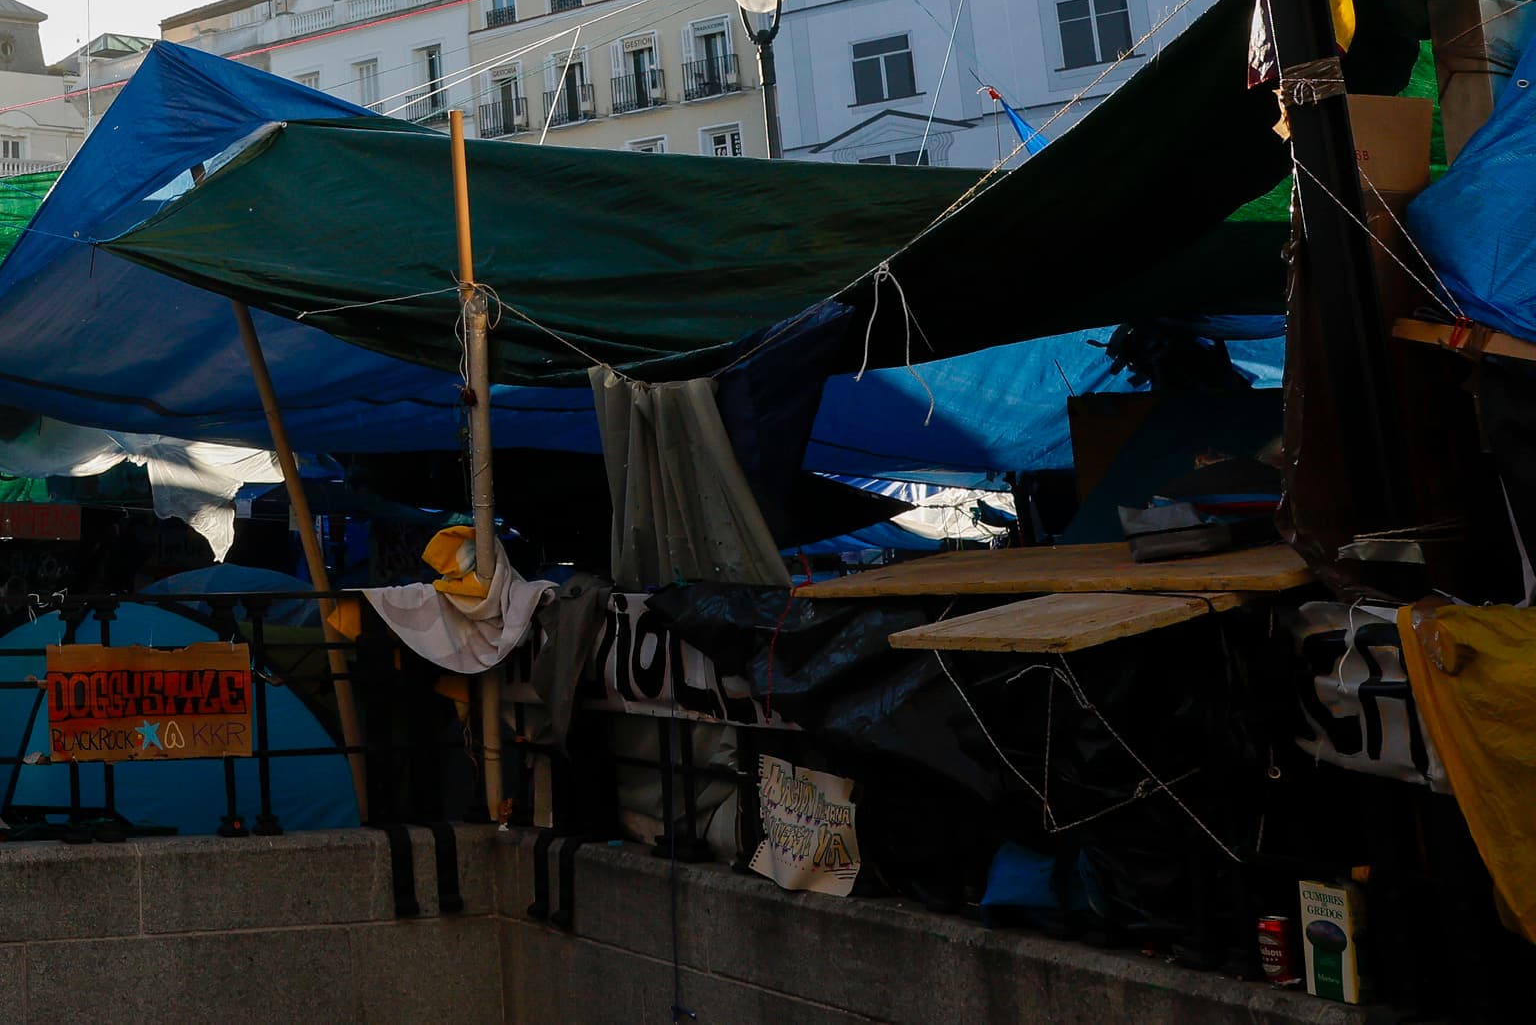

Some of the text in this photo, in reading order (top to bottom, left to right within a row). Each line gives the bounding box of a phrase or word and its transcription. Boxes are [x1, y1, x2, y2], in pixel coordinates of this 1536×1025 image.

[52, 722, 247, 752] BLACKROCK KKR
[813, 823, 854, 867] YA
[1302, 890, 1345, 906] CUMBRES
[1307, 905, 1344, 921] GREDOS
